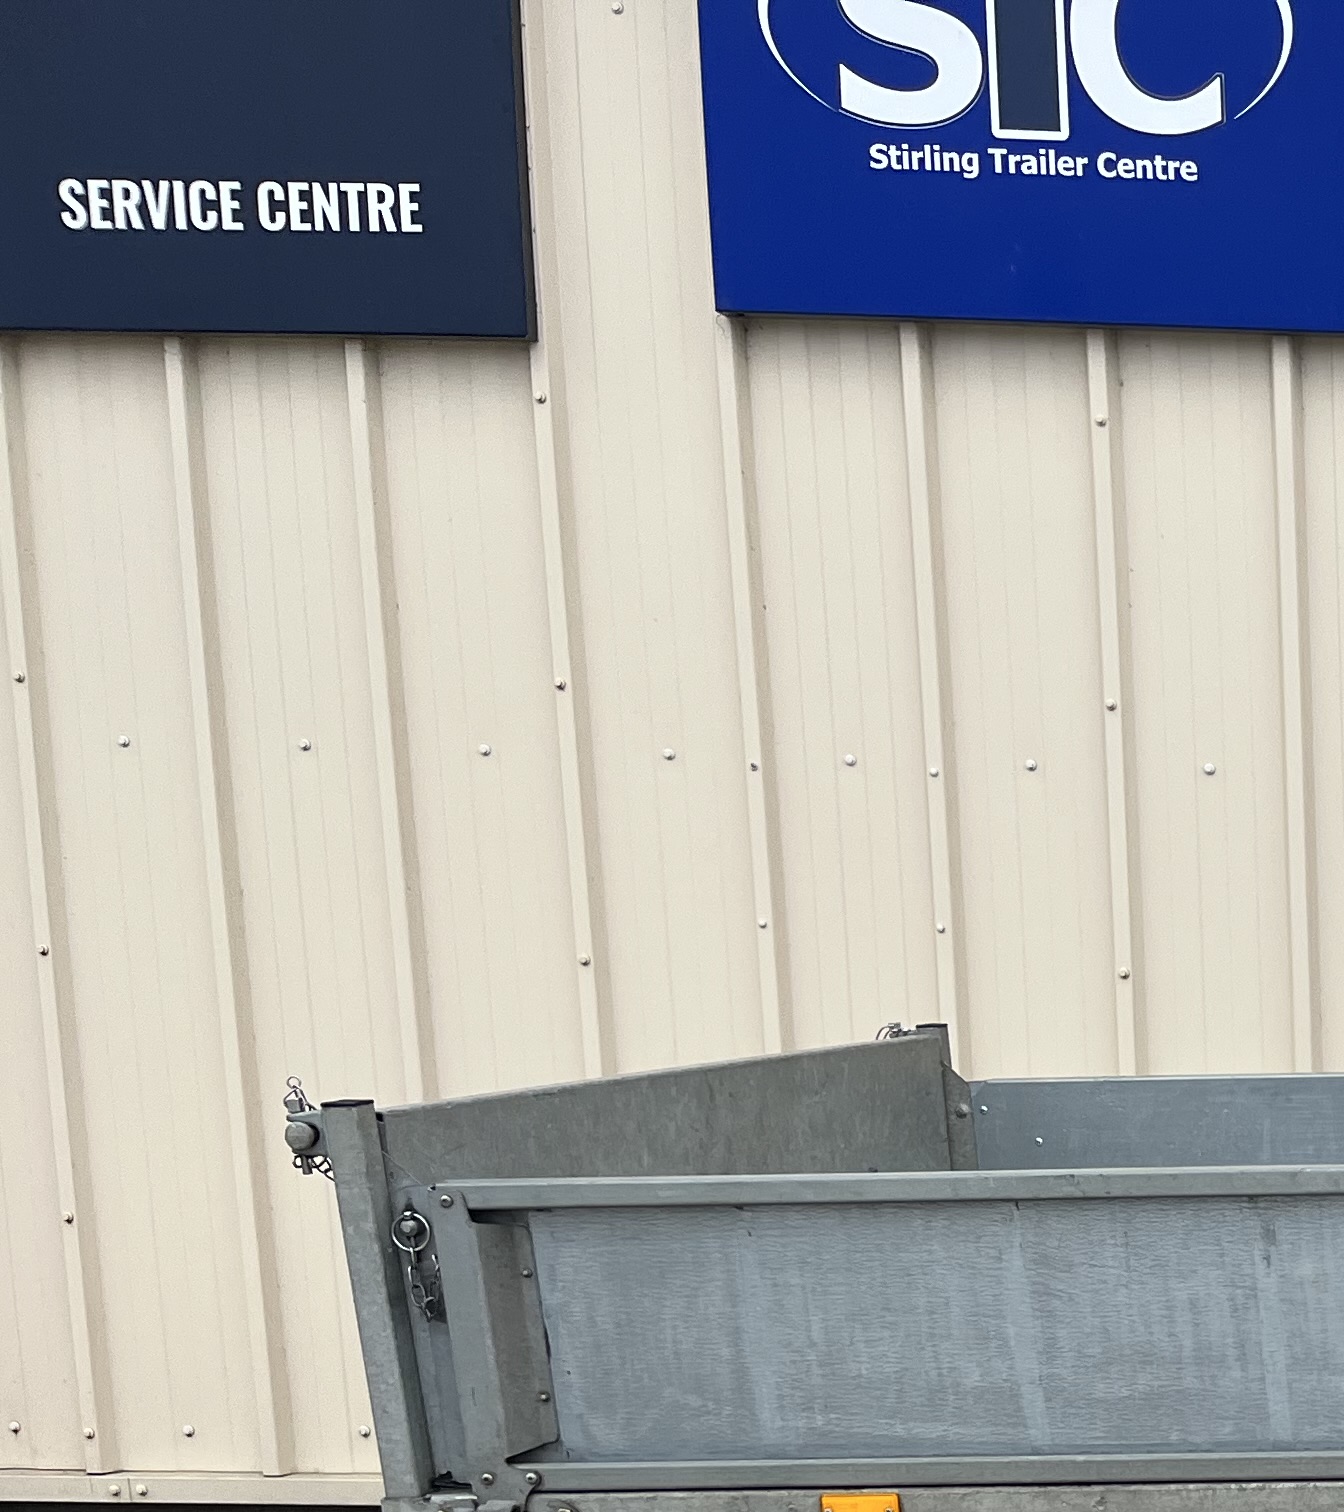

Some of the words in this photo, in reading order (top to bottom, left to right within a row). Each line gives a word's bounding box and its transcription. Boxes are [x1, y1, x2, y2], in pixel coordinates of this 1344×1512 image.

[869, 143, 979, 179] Stirling
[988, 147, 1088, 178] Trailer
[1097, 152, 1198, 182] Centre
[58, 178, 244, 231] SERVICE
[257, 181, 423, 233] CENTRE
